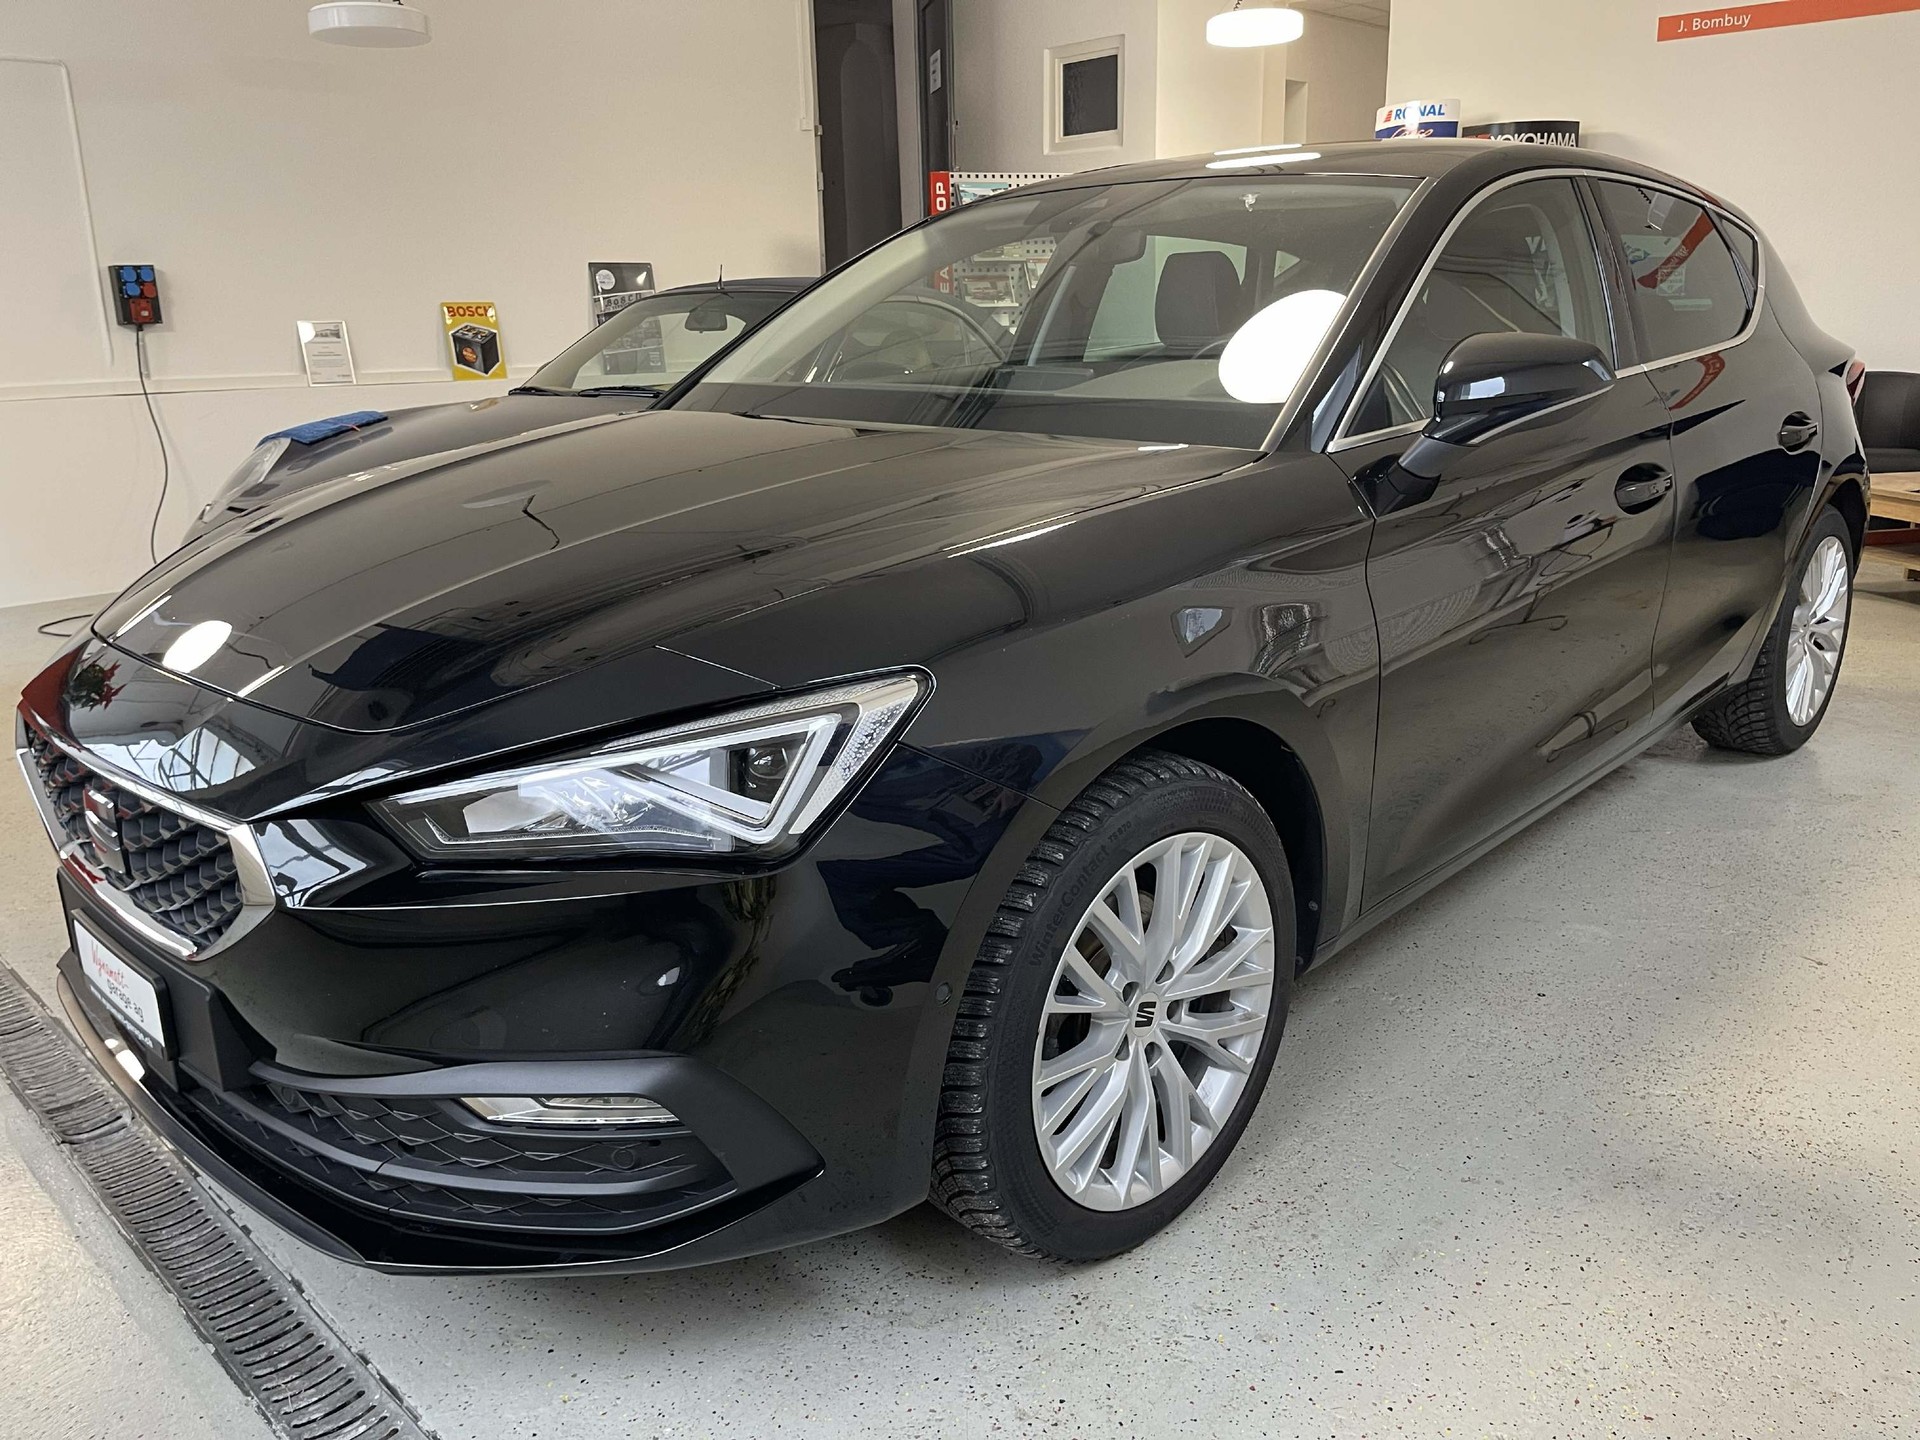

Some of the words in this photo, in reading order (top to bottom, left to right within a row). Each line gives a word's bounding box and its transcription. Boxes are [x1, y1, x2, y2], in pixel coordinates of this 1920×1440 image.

[1677, 20, 1688, 33] J.
[1692, 13, 1752, 31] Bombuy
[1394, 104, 1446, 121] RNAL
[935, 182, 947, 212] OP
[1029, 845, 1111, 967] WinterContact
